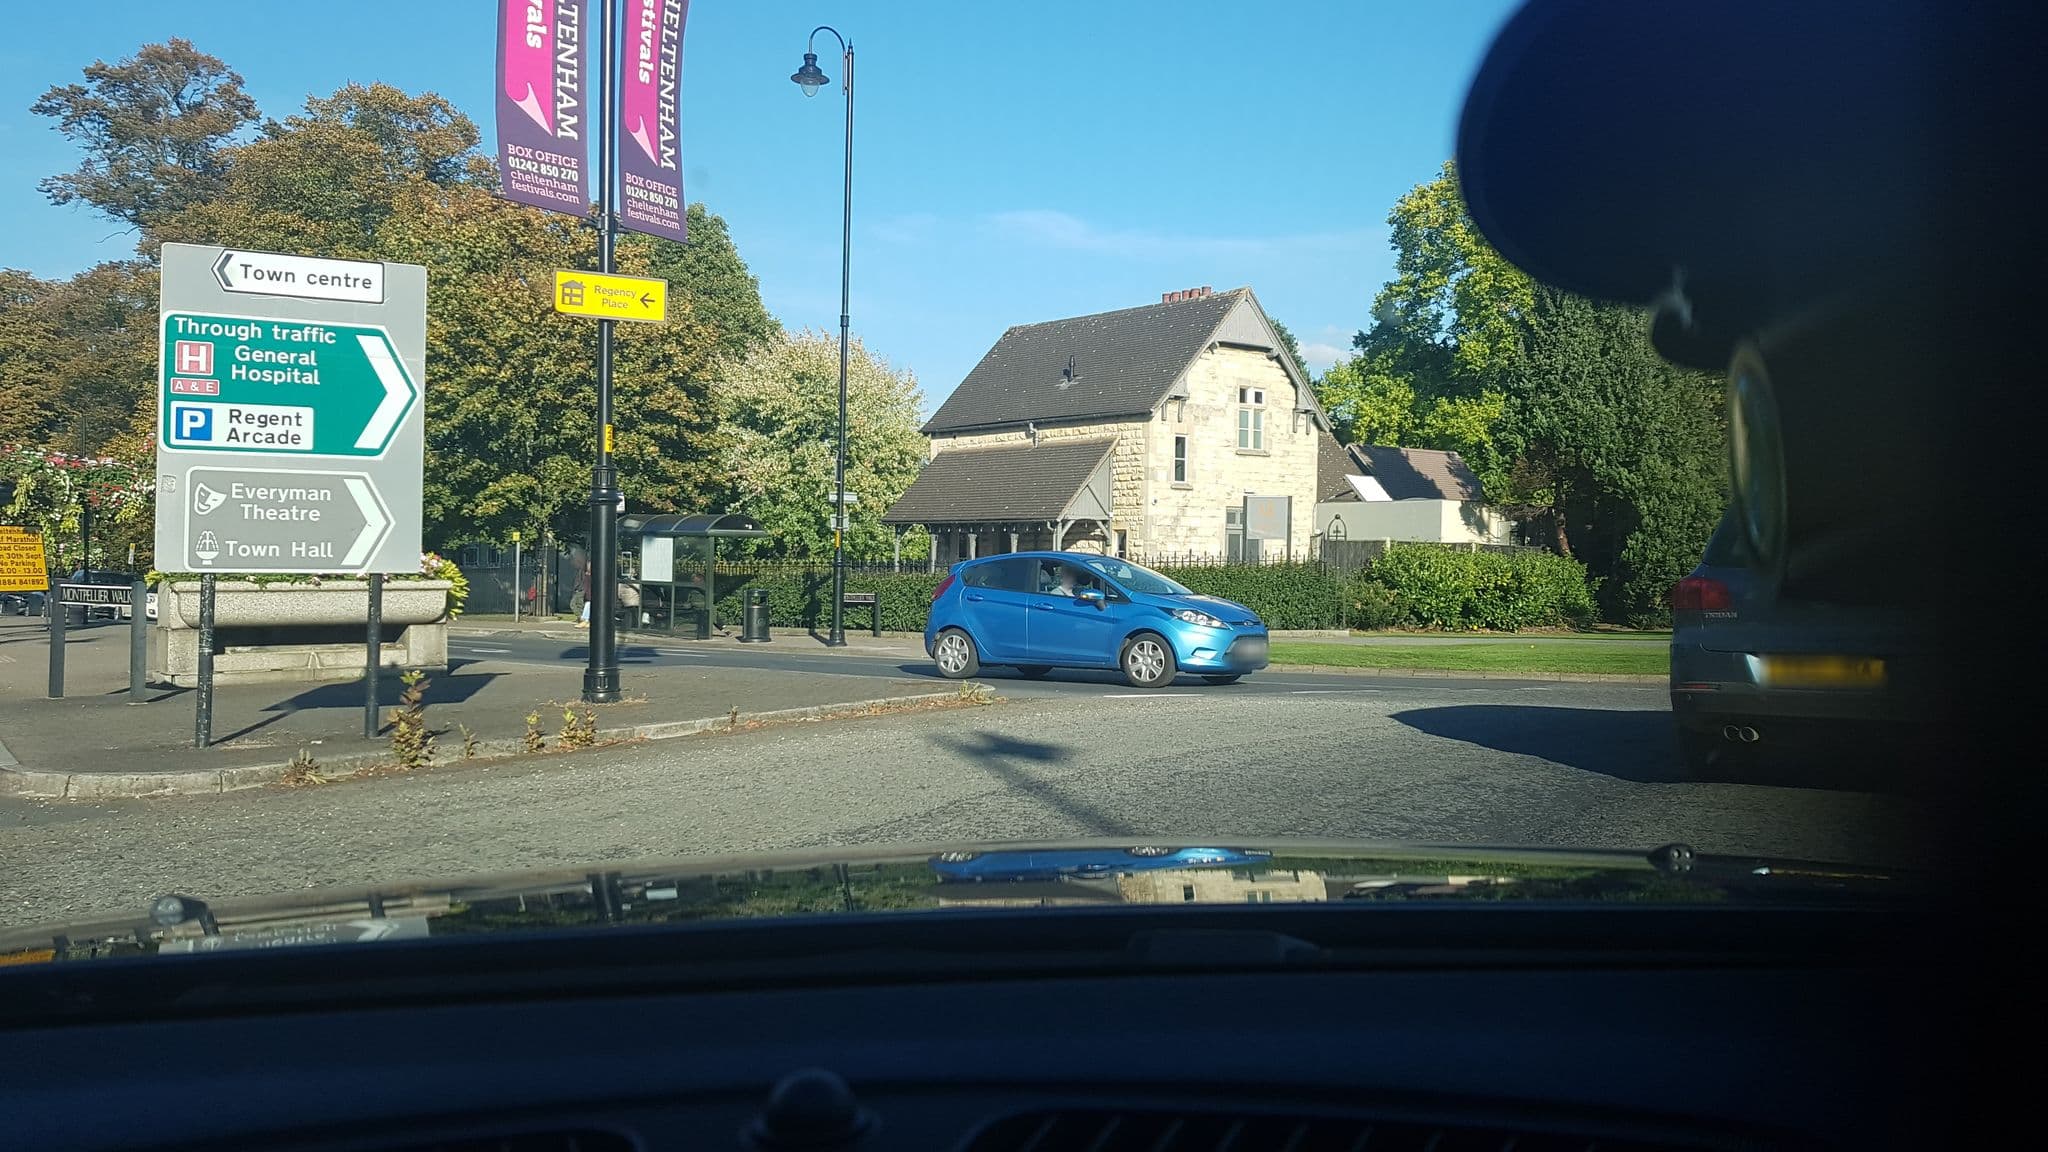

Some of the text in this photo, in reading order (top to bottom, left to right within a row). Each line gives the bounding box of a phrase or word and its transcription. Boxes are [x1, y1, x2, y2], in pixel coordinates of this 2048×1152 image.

[557, 0, 578, 141] TENHAM
[507, 144, 579, 169] BOX OFFICE
[508, 157, 579, 182] 01242 850 270
[511, 170, 578, 194] cheltenham
[511, 180, 580, 205] festivals.com
[625, 172, 678, 198] BOX OFFICE
[625, 184, 678, 210] 01242 850 270
[627, 197, 678, 220] cheltenham
[627, 208, 681, 231] festivals.com
[240, 264, 373, 290] Town centre
[594, 285, 637, 299] Regency
[601, 298, 629, 309] Place
[174, 317, 336, 344] Through traffic
[181, 344, 207, 372] H
[234, 346, 317, 366] General
[231, 364, 321, 385] Hospital
[174, 381, 214, 393] A & E
[182, 410, 205, 438] P
[229, 409, 303, 428] Regent
[226, 428, 302, 445] Arcade
[231, 483, 331, 503] Everyman
[240, 504, 321, 522] Theatre
[6, 535, 39, 543] Marathon
[225, 541, 334, 558] Town Hall
[10, 560, 37, 568] Parking
[62, 587, 133, 604] MONTPELLIER WALK
